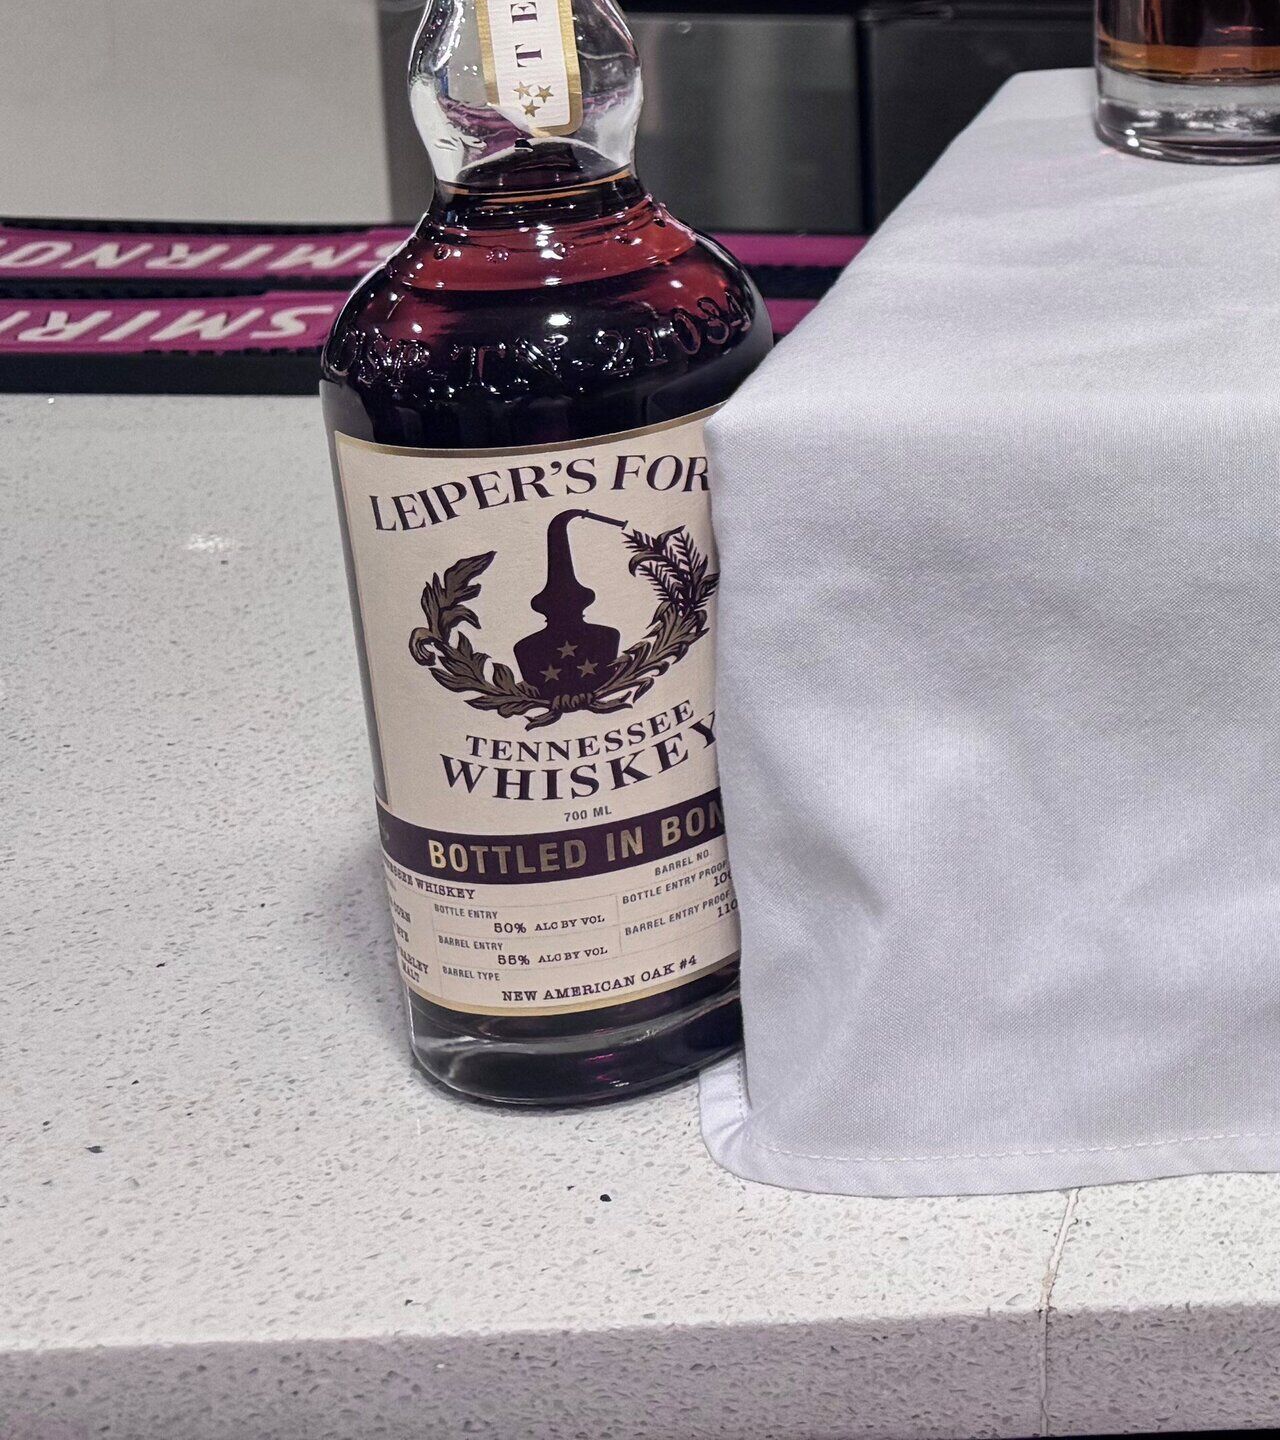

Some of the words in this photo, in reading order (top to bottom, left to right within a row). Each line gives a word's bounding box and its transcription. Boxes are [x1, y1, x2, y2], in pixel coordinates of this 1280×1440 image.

[369, 458, 597, 532] LEIPER'S
[465, 699, 695, 763] TENNESSEE
[439, 711, 718, 801] WHISKEY
[564, 810, 588, 823] 700
[593, 805, 612, 818] ML
[428, 838, 588, 875] BOTTLED
[606, 825, 644, 862] IN
[654, 856, 694, 877] BARREL
[696, 849, 710, 863] NO
[412, 876, 476, 901] WHISKEY
[622, 885, 662, 905] BOTTLE
[665, 873, 697, 893] ENTRY
[434, 903, 465, 918] BOTTLE
[468, 908, 499, 920] ENTRY
[493, 922, 527, 935] 50%
[534, 920, 559, 932] ALC
[561, 918, 577, 929] BY
[583, 914, 605, 926] VOL
[625, 918, 666, 937] BARREL
[669, 903, 701, 924] ENTRY
[438, 934, 471, 950] BARREL
[473, 938, 504, 952] ENTRY
[497, 953, 531, 966] 55%
[538, 952, 562, 964] ALC
[565, 950, 581, 961] BY
[584, 945, 608, 957] VOL
[442, 965, 475, 980] BARREL
[478, 970, 501, 982] TYPE
[501, 989, 537, 1002] NEW
[543, 974, 636, 1001] AMERICAN
[640, 962, 675, 984] OAK
[678, 953, 698, 972] #4
